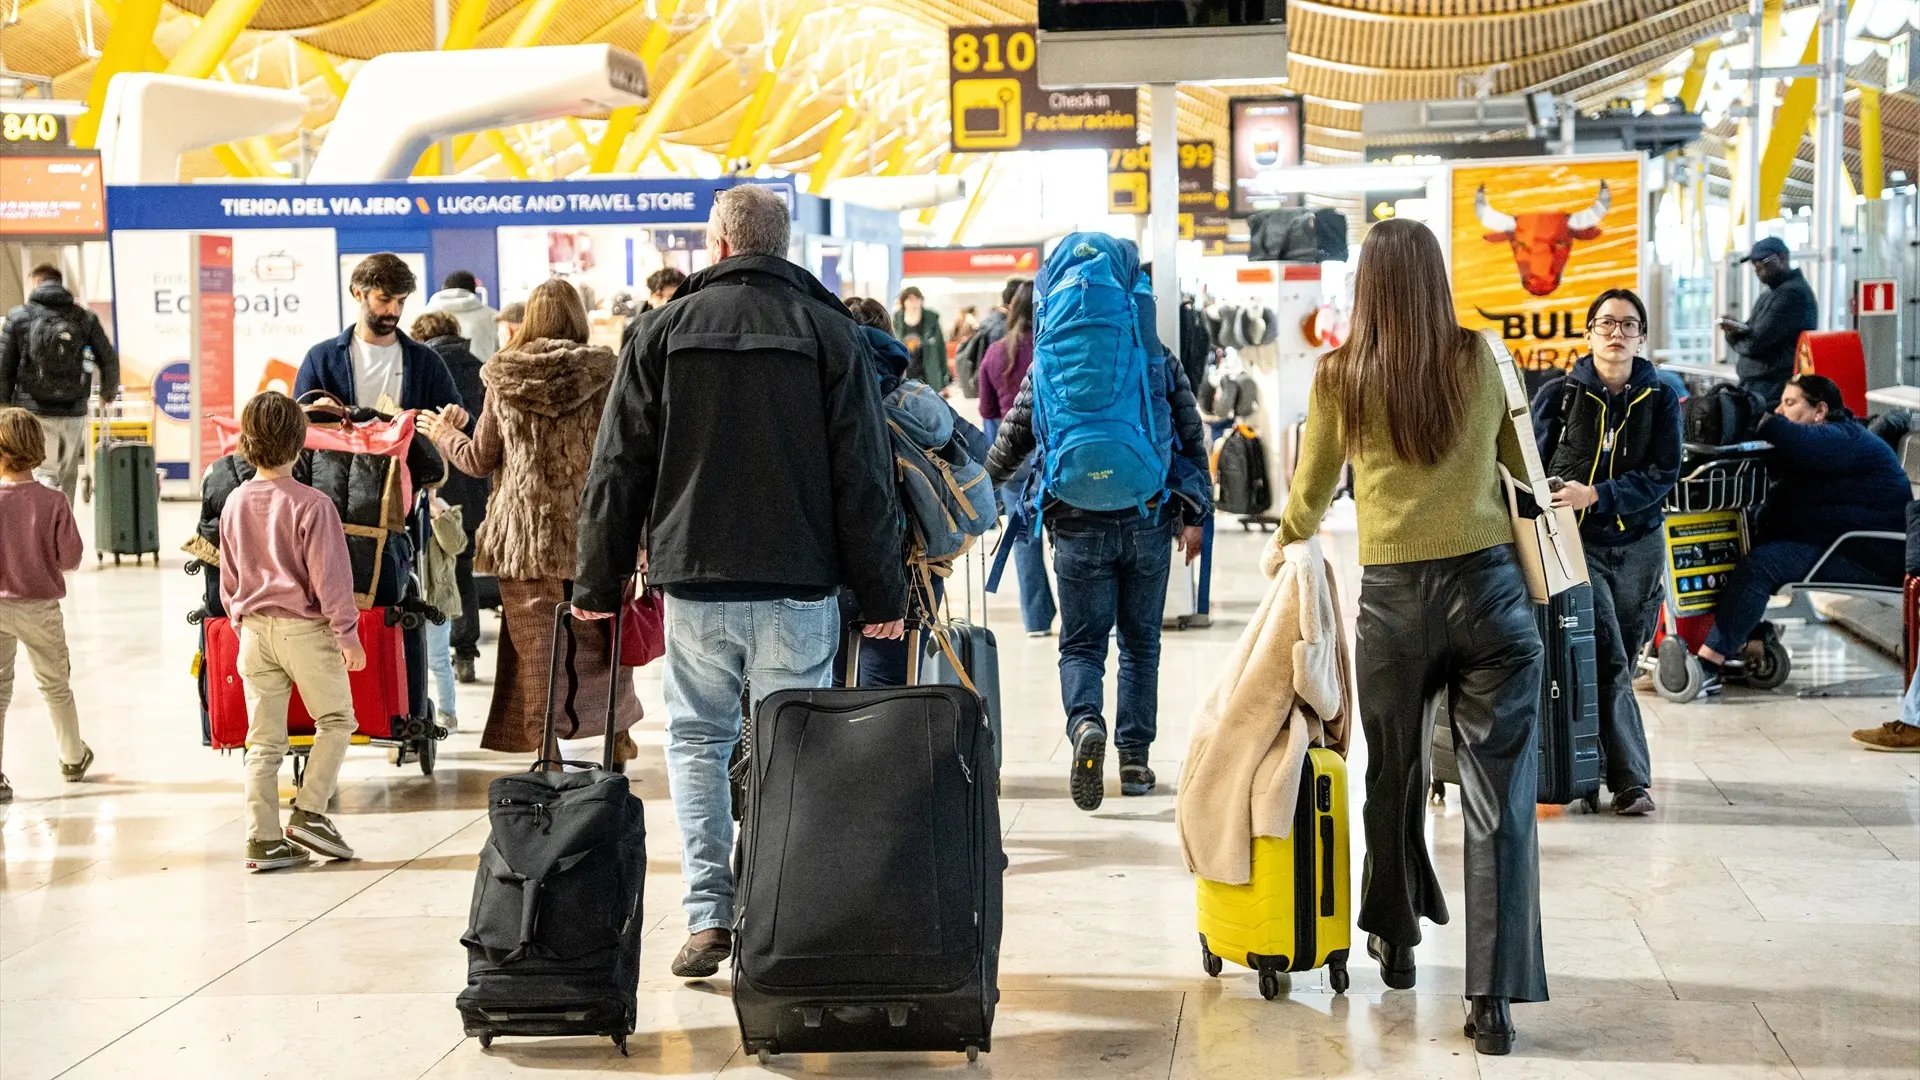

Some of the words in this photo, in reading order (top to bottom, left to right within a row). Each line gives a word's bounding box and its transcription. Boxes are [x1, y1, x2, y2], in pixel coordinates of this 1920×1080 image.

[952, 31, 1036, 73] 810
[1049, 91, 1111, 110] Check-in
[3, 113, 58, 141] 840
[1024, 109, 1136, 132] Facturación
[1178, 143, 1213, 169] 99
[220, 197, 291, 217] TIENDA
[291, 197, 329, 217] DEL
[329, 196, 412, 216] VIAJERO
[437, 195, 525, 215] LUGGAGE
[525, 195, 566, 213] AND
[567, 193, 636, 213] TRAVEL
[637, 192, 696, 211] STORE
[1502, 312, 1584, 340] BUL
